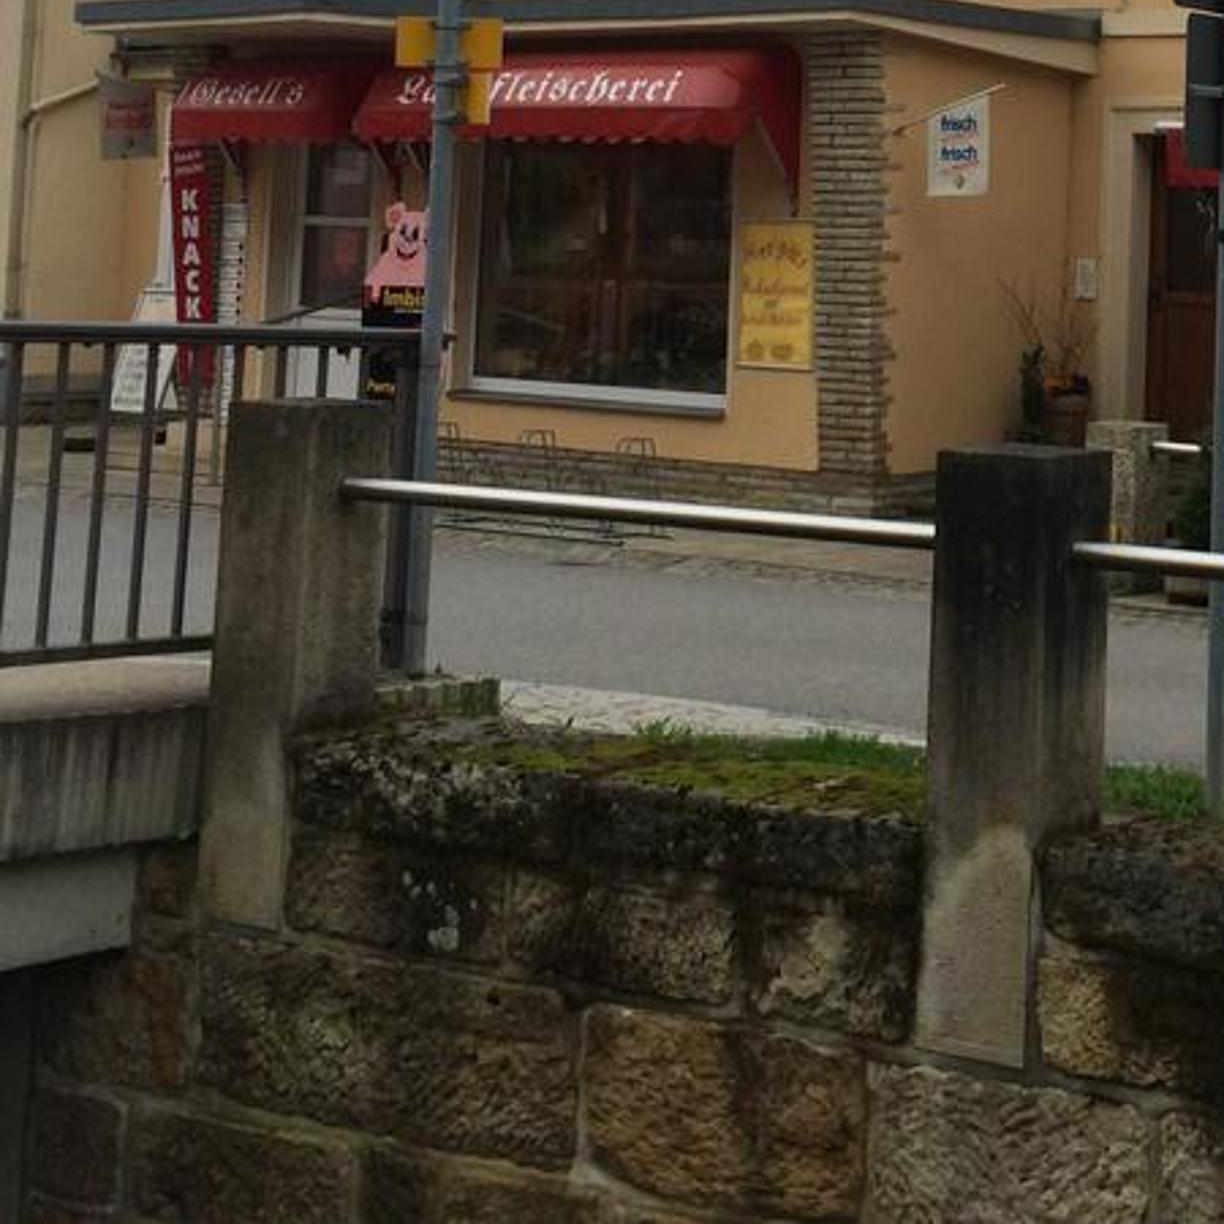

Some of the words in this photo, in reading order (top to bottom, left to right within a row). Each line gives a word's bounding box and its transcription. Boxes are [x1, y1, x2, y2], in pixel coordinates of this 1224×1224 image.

[396, 69, 684, 105] Lafleischerei
[180, 188, 201, 373] KNACK
[383, 287, 429, 308] Imbi
